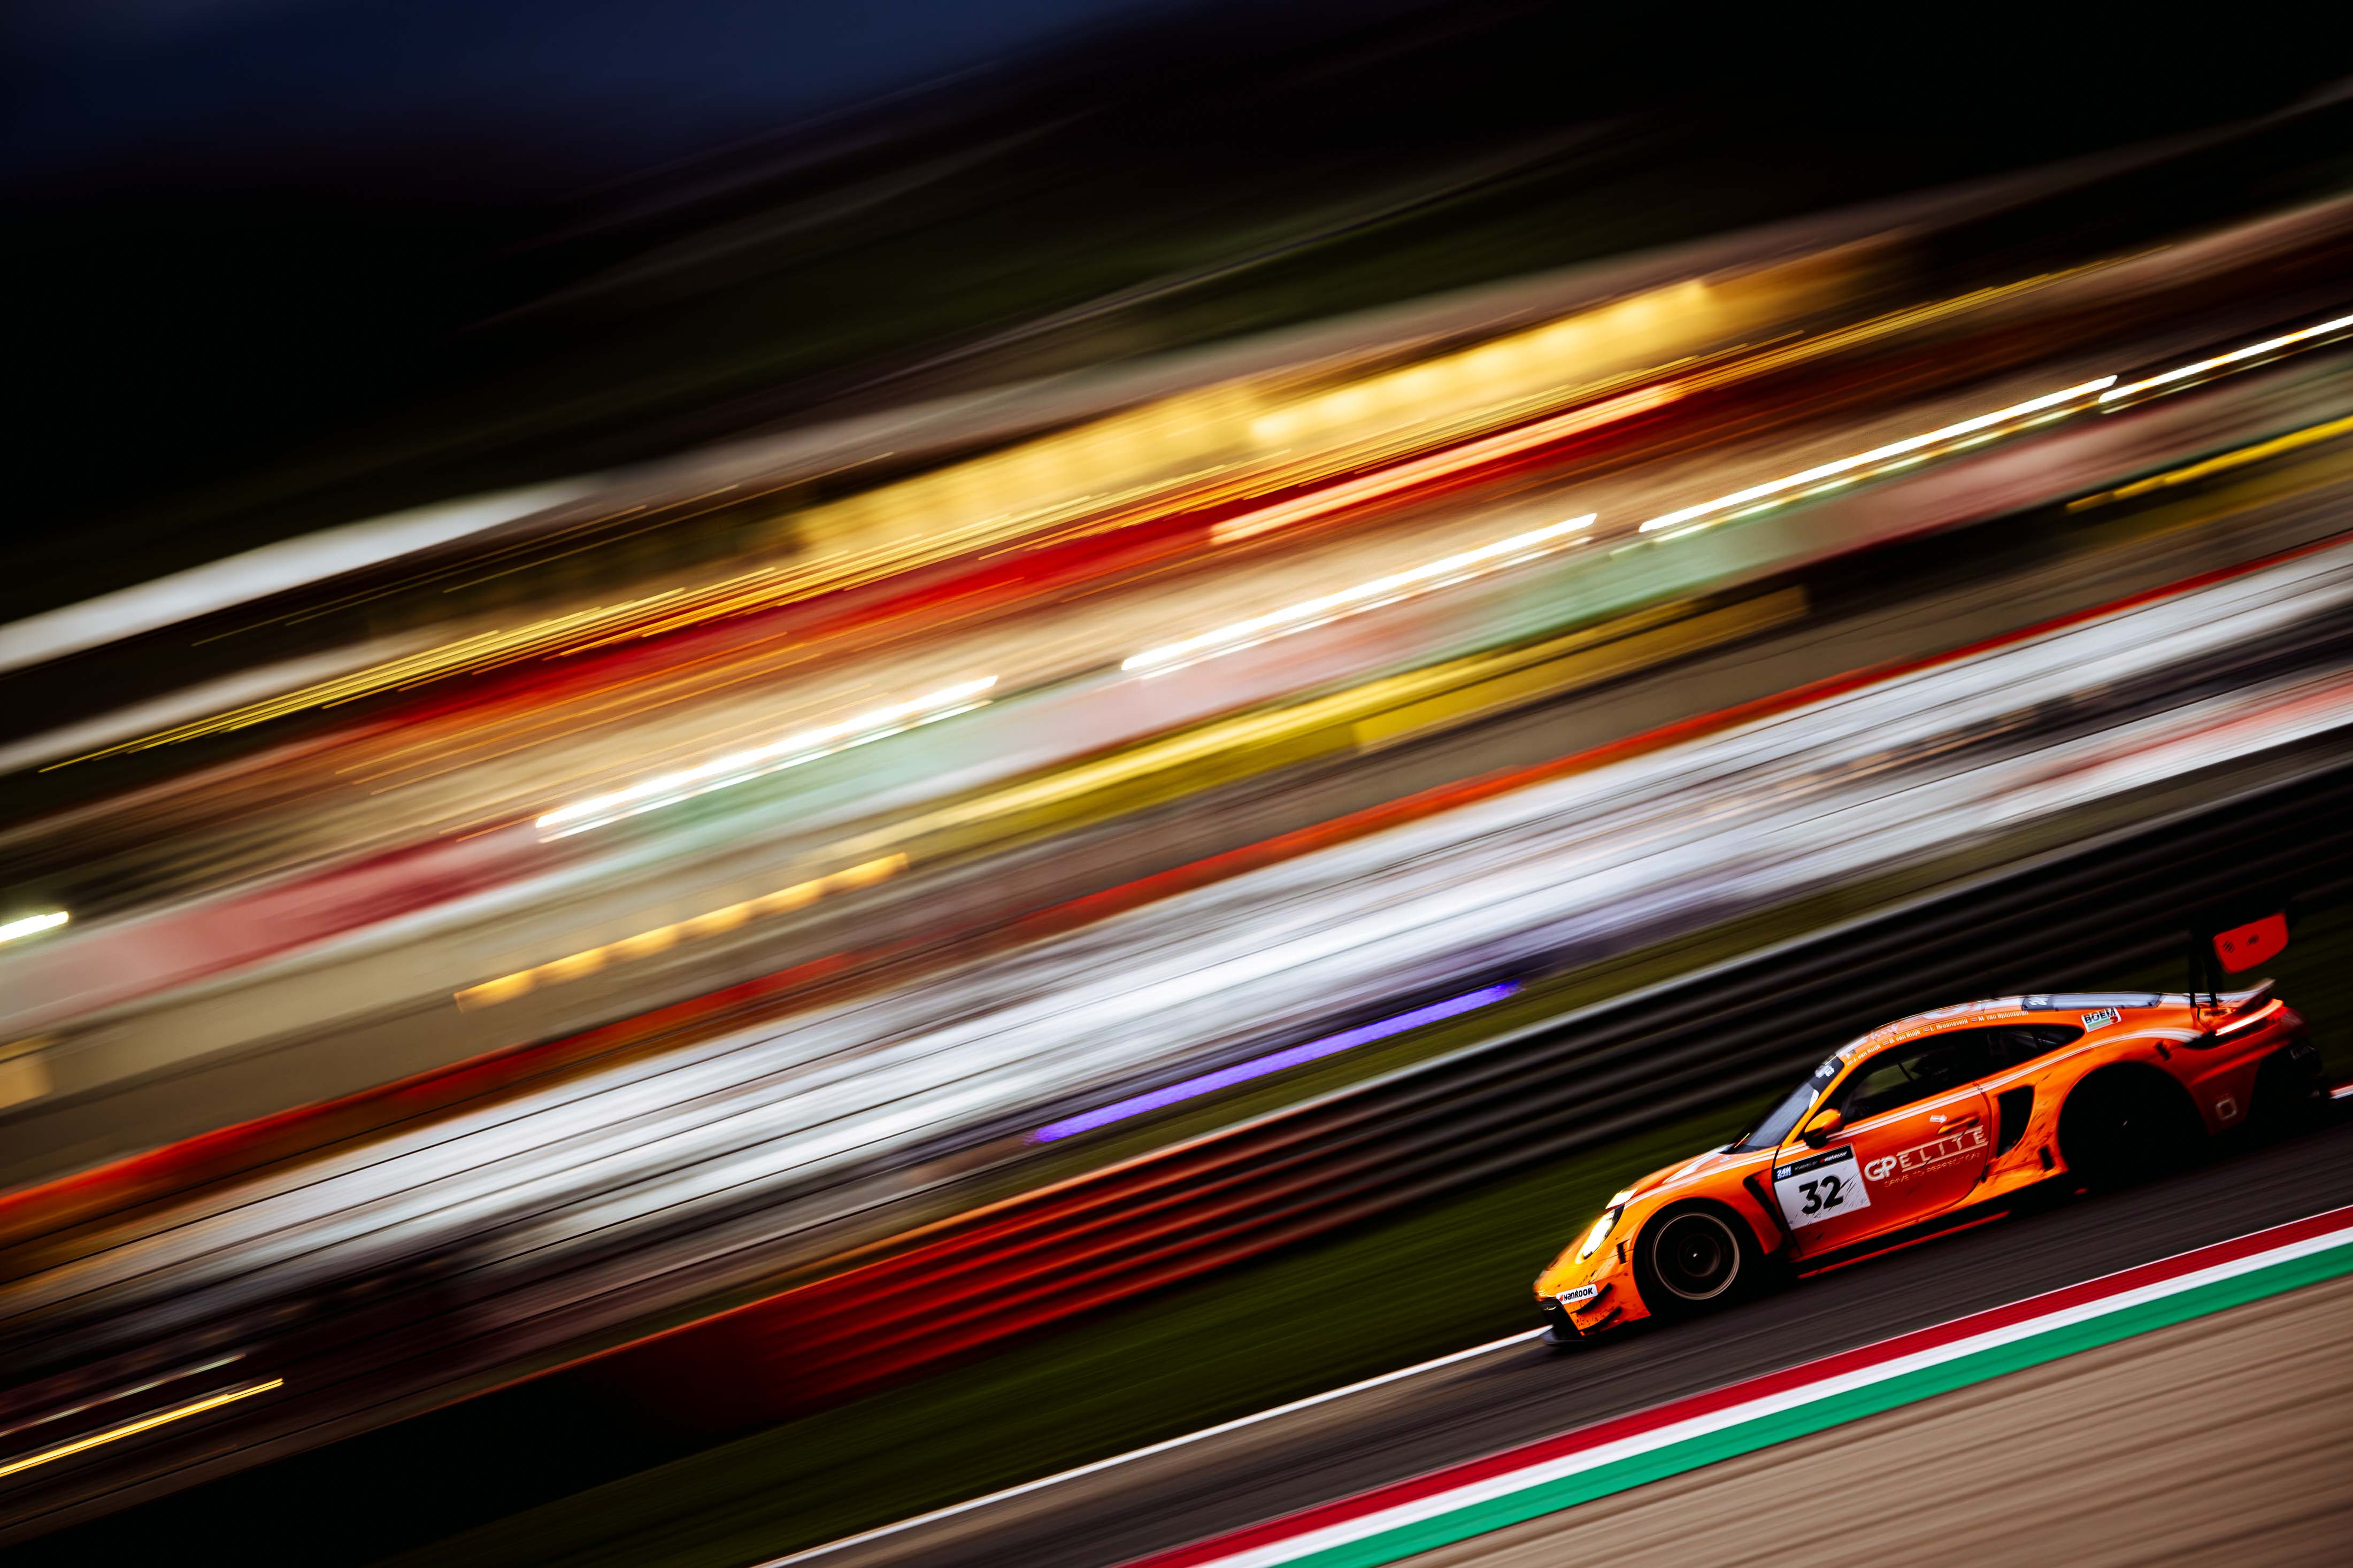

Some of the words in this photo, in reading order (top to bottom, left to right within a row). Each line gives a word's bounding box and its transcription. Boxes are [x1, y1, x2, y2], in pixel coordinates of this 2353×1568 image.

[2083, 1008, 2116, 1024] BOEM
[1777, 1165, 1792, 1177] 24H
[1798, 1175, 1844, 1216] 32
